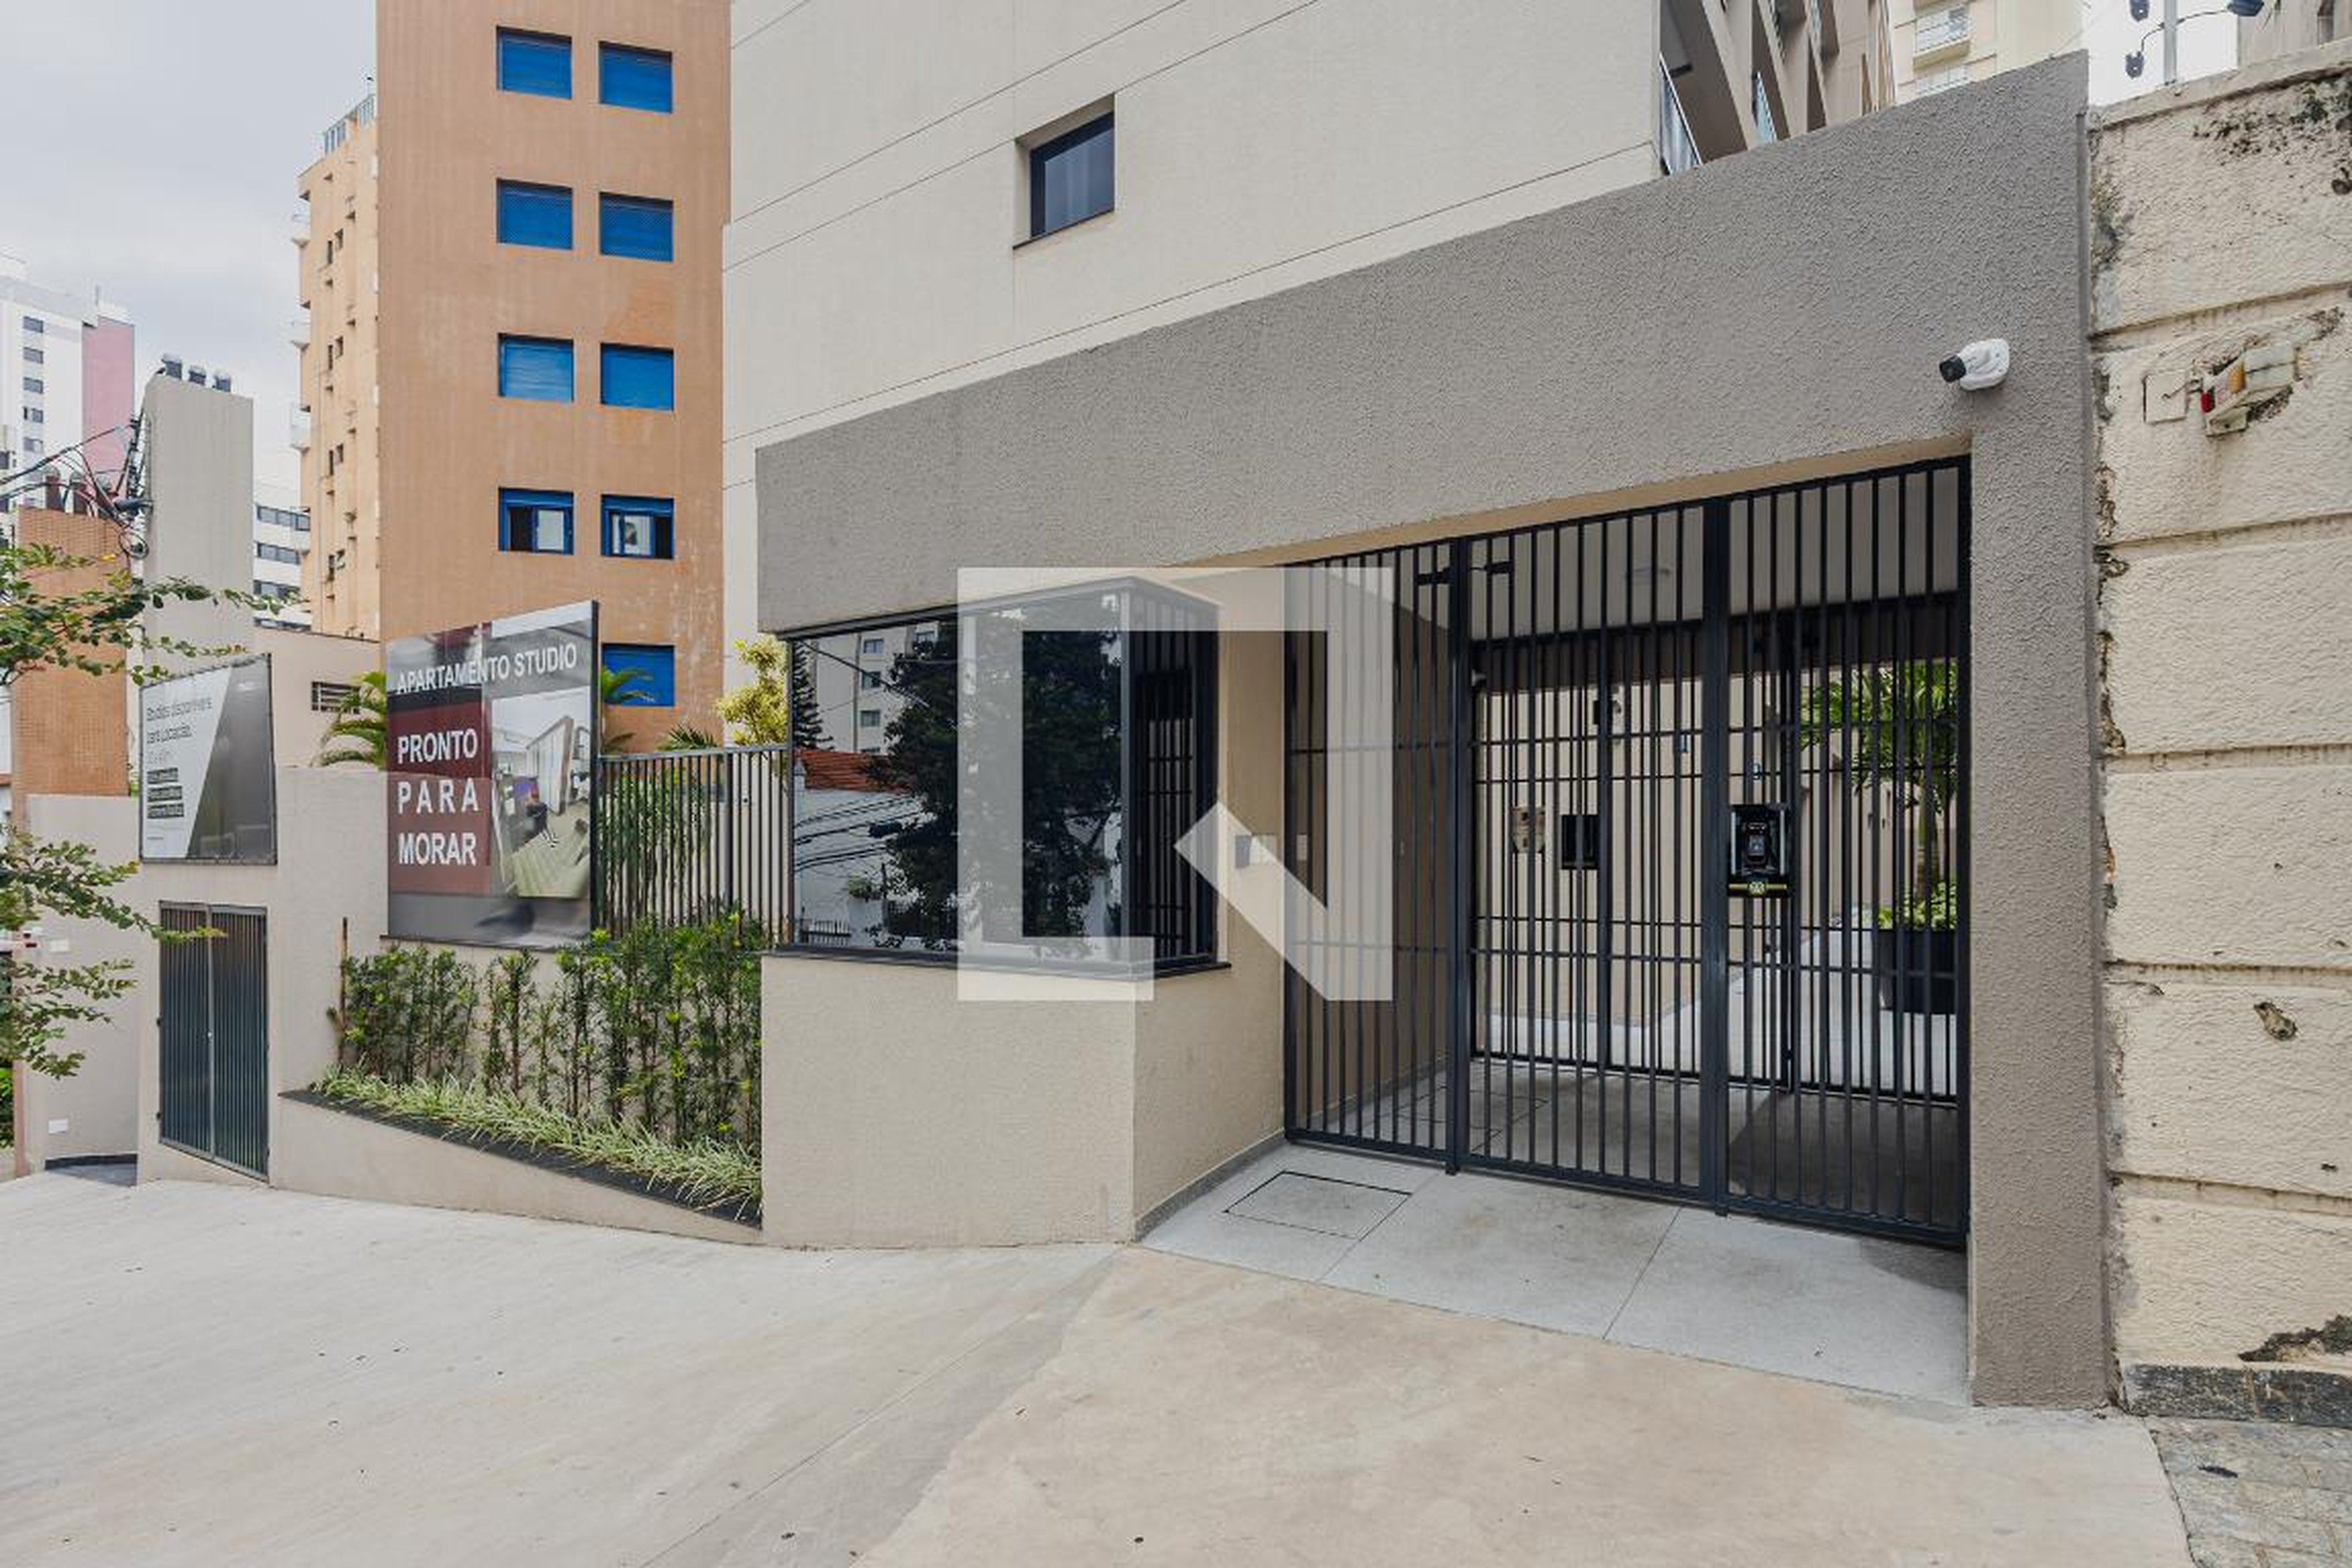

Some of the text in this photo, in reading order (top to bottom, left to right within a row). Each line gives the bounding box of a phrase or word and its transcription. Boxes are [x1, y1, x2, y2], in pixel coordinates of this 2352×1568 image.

[397, 643, 576, 694] APARTAMENTO STUDIO
[398, 728, 478, 764] PRONTO
[398, 777, 479, 814] PARA
[399, 832, 476, 865] MORAR
